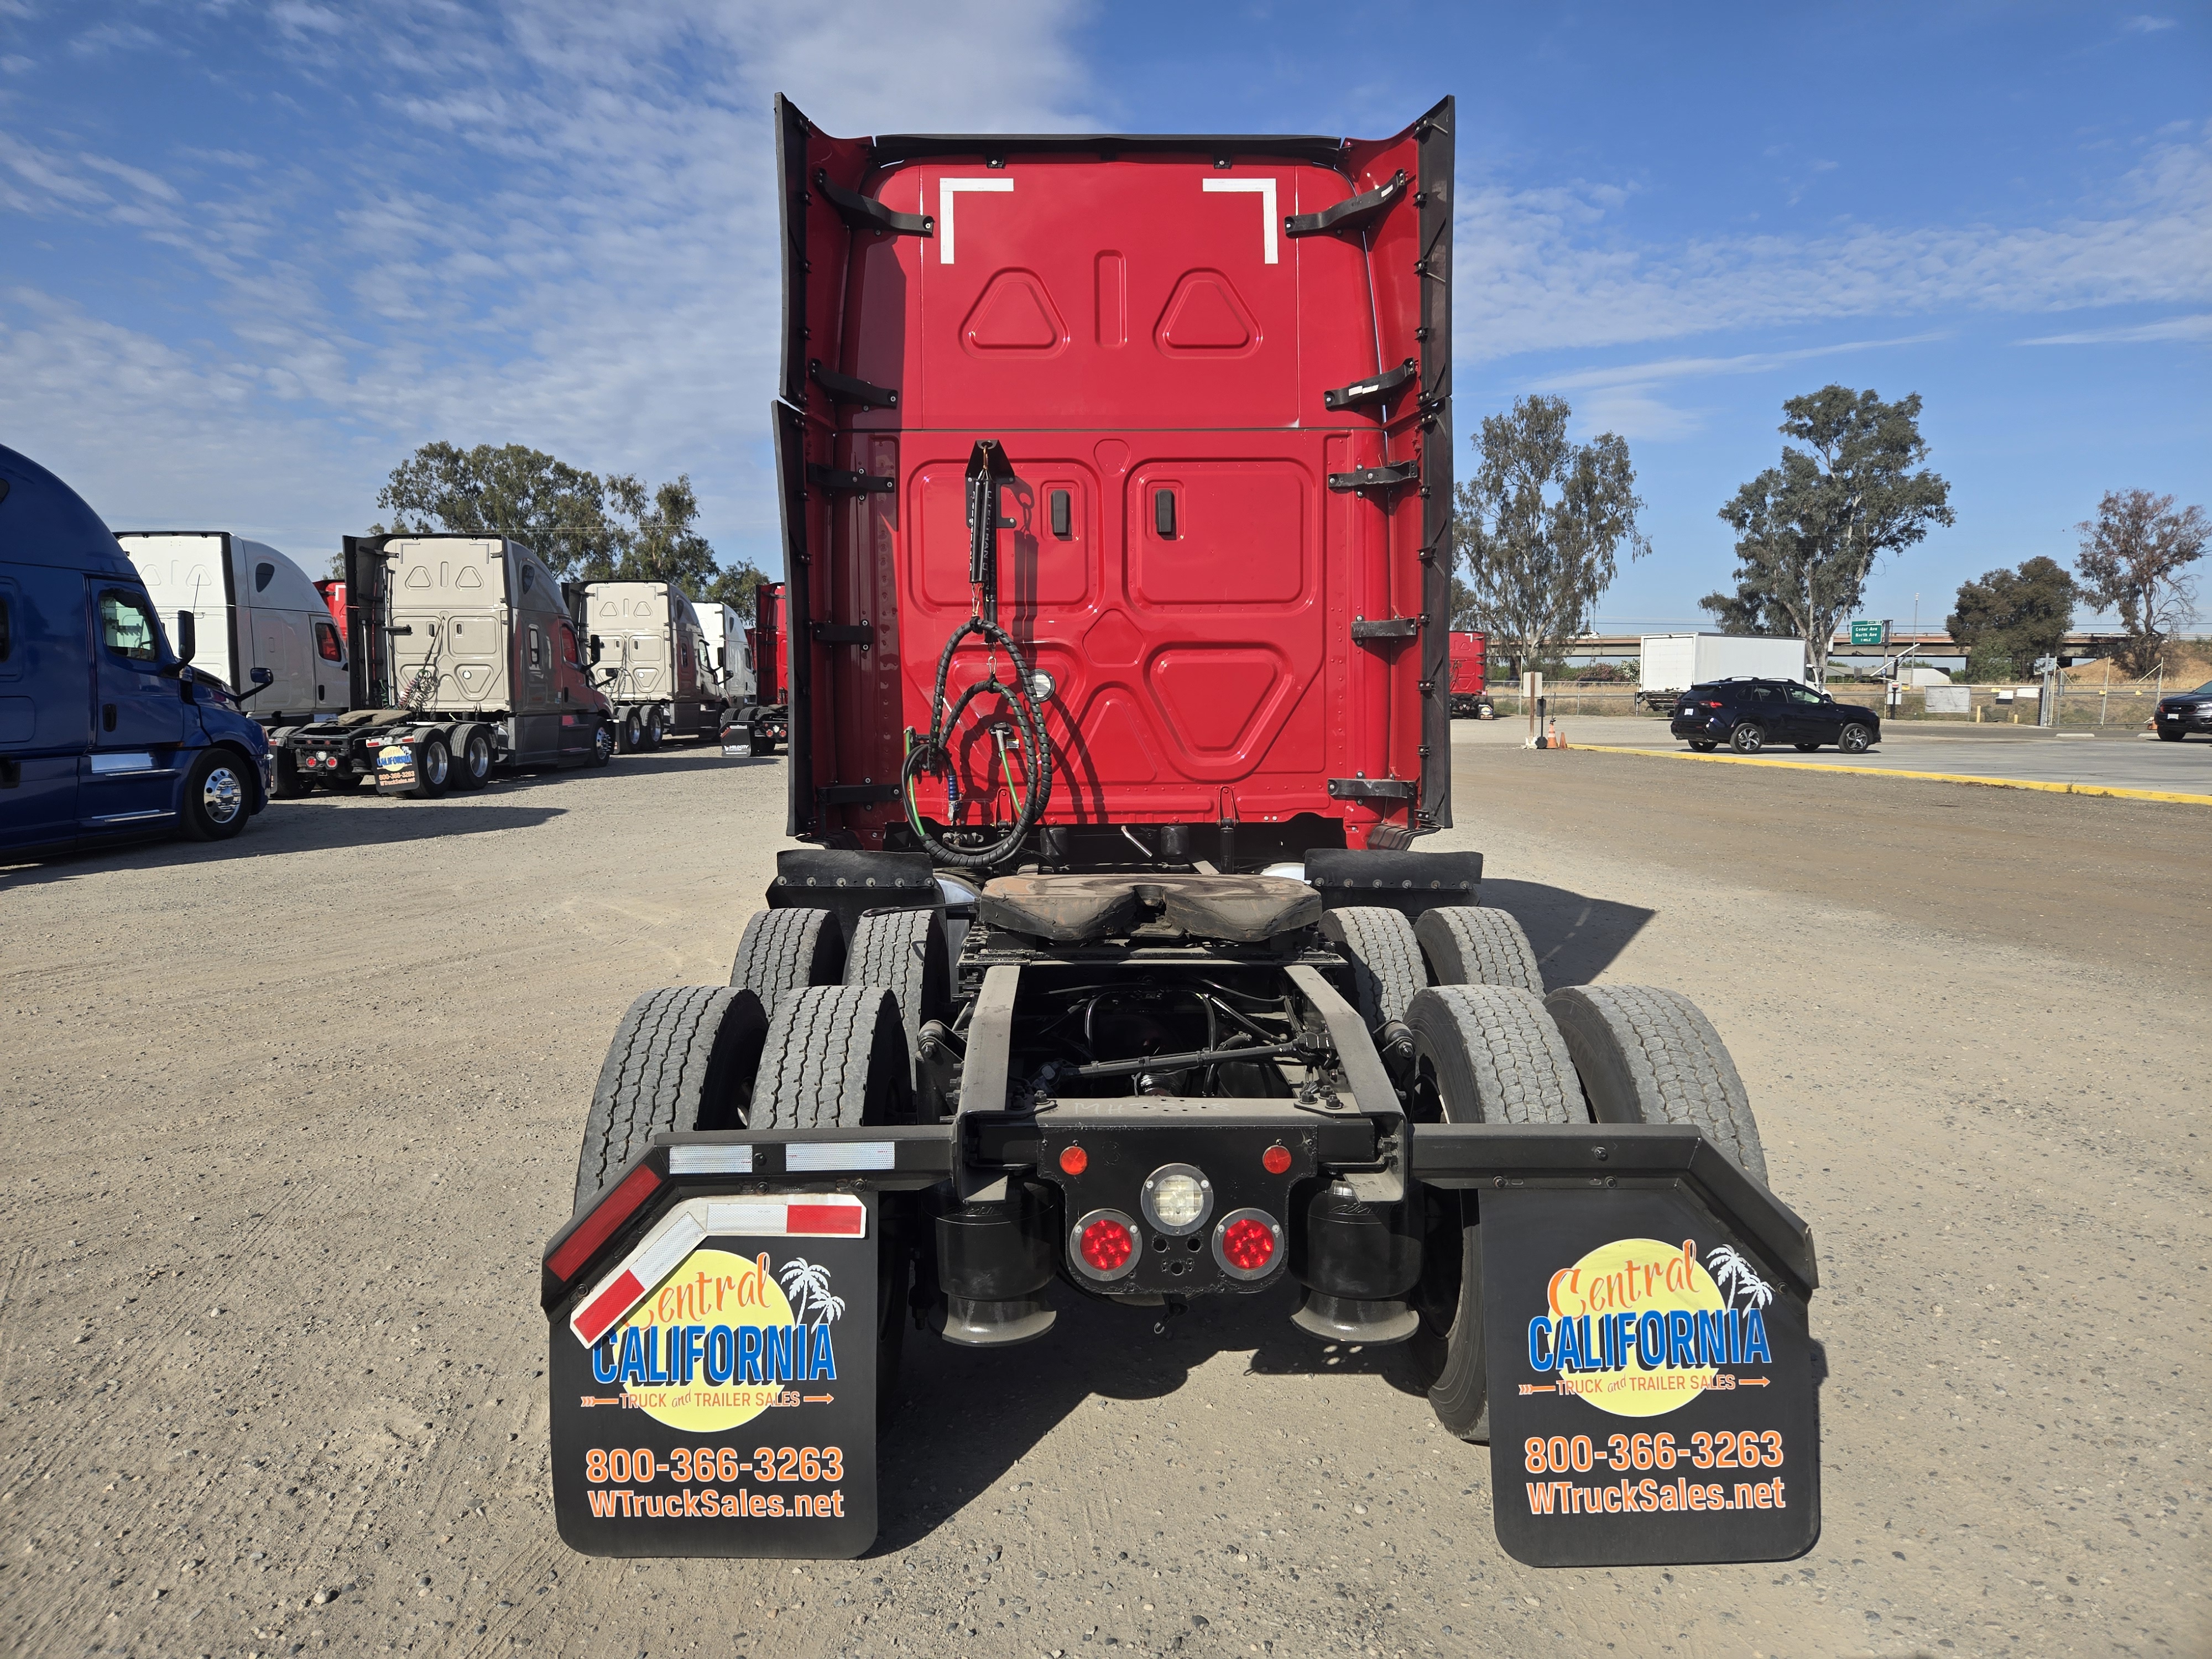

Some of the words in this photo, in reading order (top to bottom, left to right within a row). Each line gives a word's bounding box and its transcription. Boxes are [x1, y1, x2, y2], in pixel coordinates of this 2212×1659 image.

[377, 755, 412, 766] CALIFORNIA
[1547, 1239, 1700, 1320] Central
[592, 1324, 837, 1385] CALIFORNIA
[1528, 1307, 1772, 1371] CALIFORNIA
[619, 1392, 667, 1408] TRUCK
[671, 1389, 692, 1408] and
[694, 1392, 750, 1407] TRAILER
[755, 1391, 801, 1407] SALES
[1556, 1379, 1603, 1395] TRUCK
[1607, 1374, 1626, 1394] and
[1629, 1375, 1686, 1391] TRAILER
[1690, 1374, 1736, 1391] SALES
[586, 1446, 844, 1484] 800-366-3263
[1525, 1430, 1785, 1474] 800-366-3263
[587, 1488, 845, 1518] WTruckSales.net
[1526, 1476, 1786, 1515] WTruckSales.net
